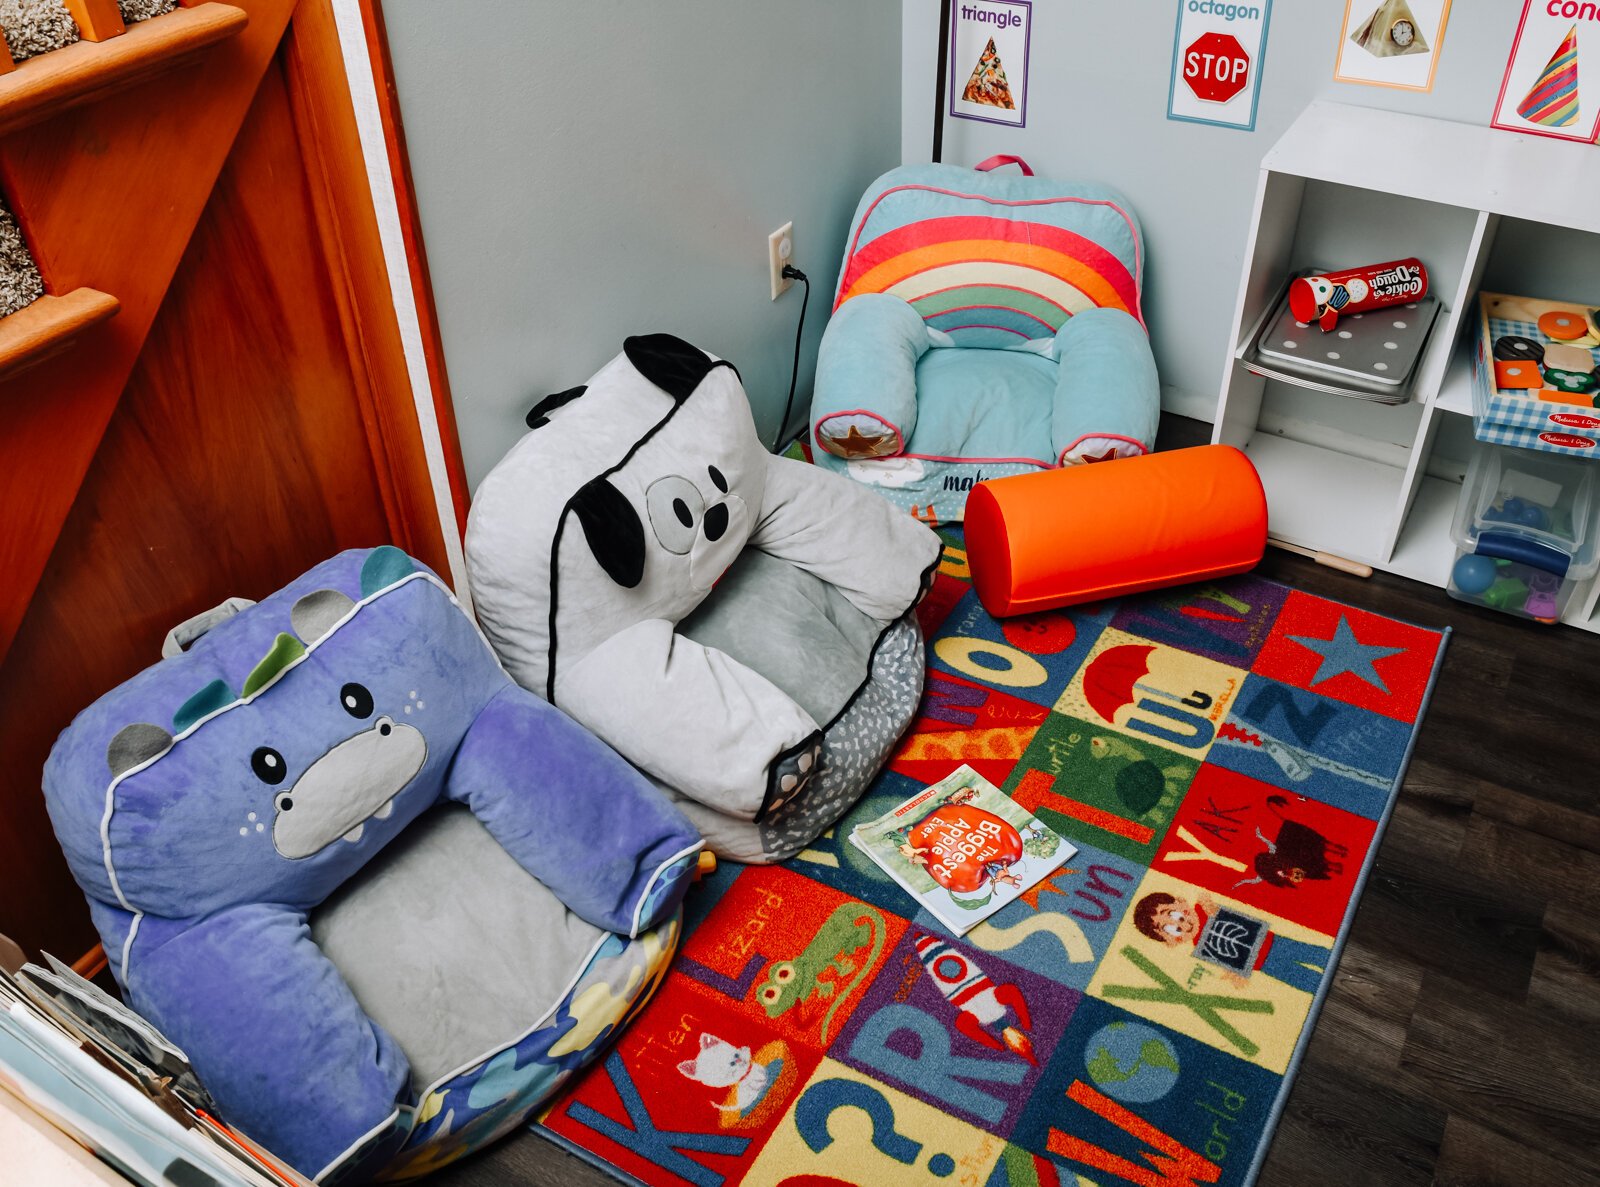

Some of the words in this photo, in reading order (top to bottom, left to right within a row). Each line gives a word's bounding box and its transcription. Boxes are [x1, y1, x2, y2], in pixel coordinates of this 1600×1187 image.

[961, 5, 1022, 29] triangle
[1188, 0, 1260, 21] octagon
[1185, 51, 1249, 83] STOP
[1368, 265, 1411, 288] Dough
[1386, 277, 1423, 295] Cookie
[920, 816, 945, 839] Ever
[931, 817, 971, 856] Apple
[932, 819, 1002, 879] Biggest
[976, 845, 999, 862] The
